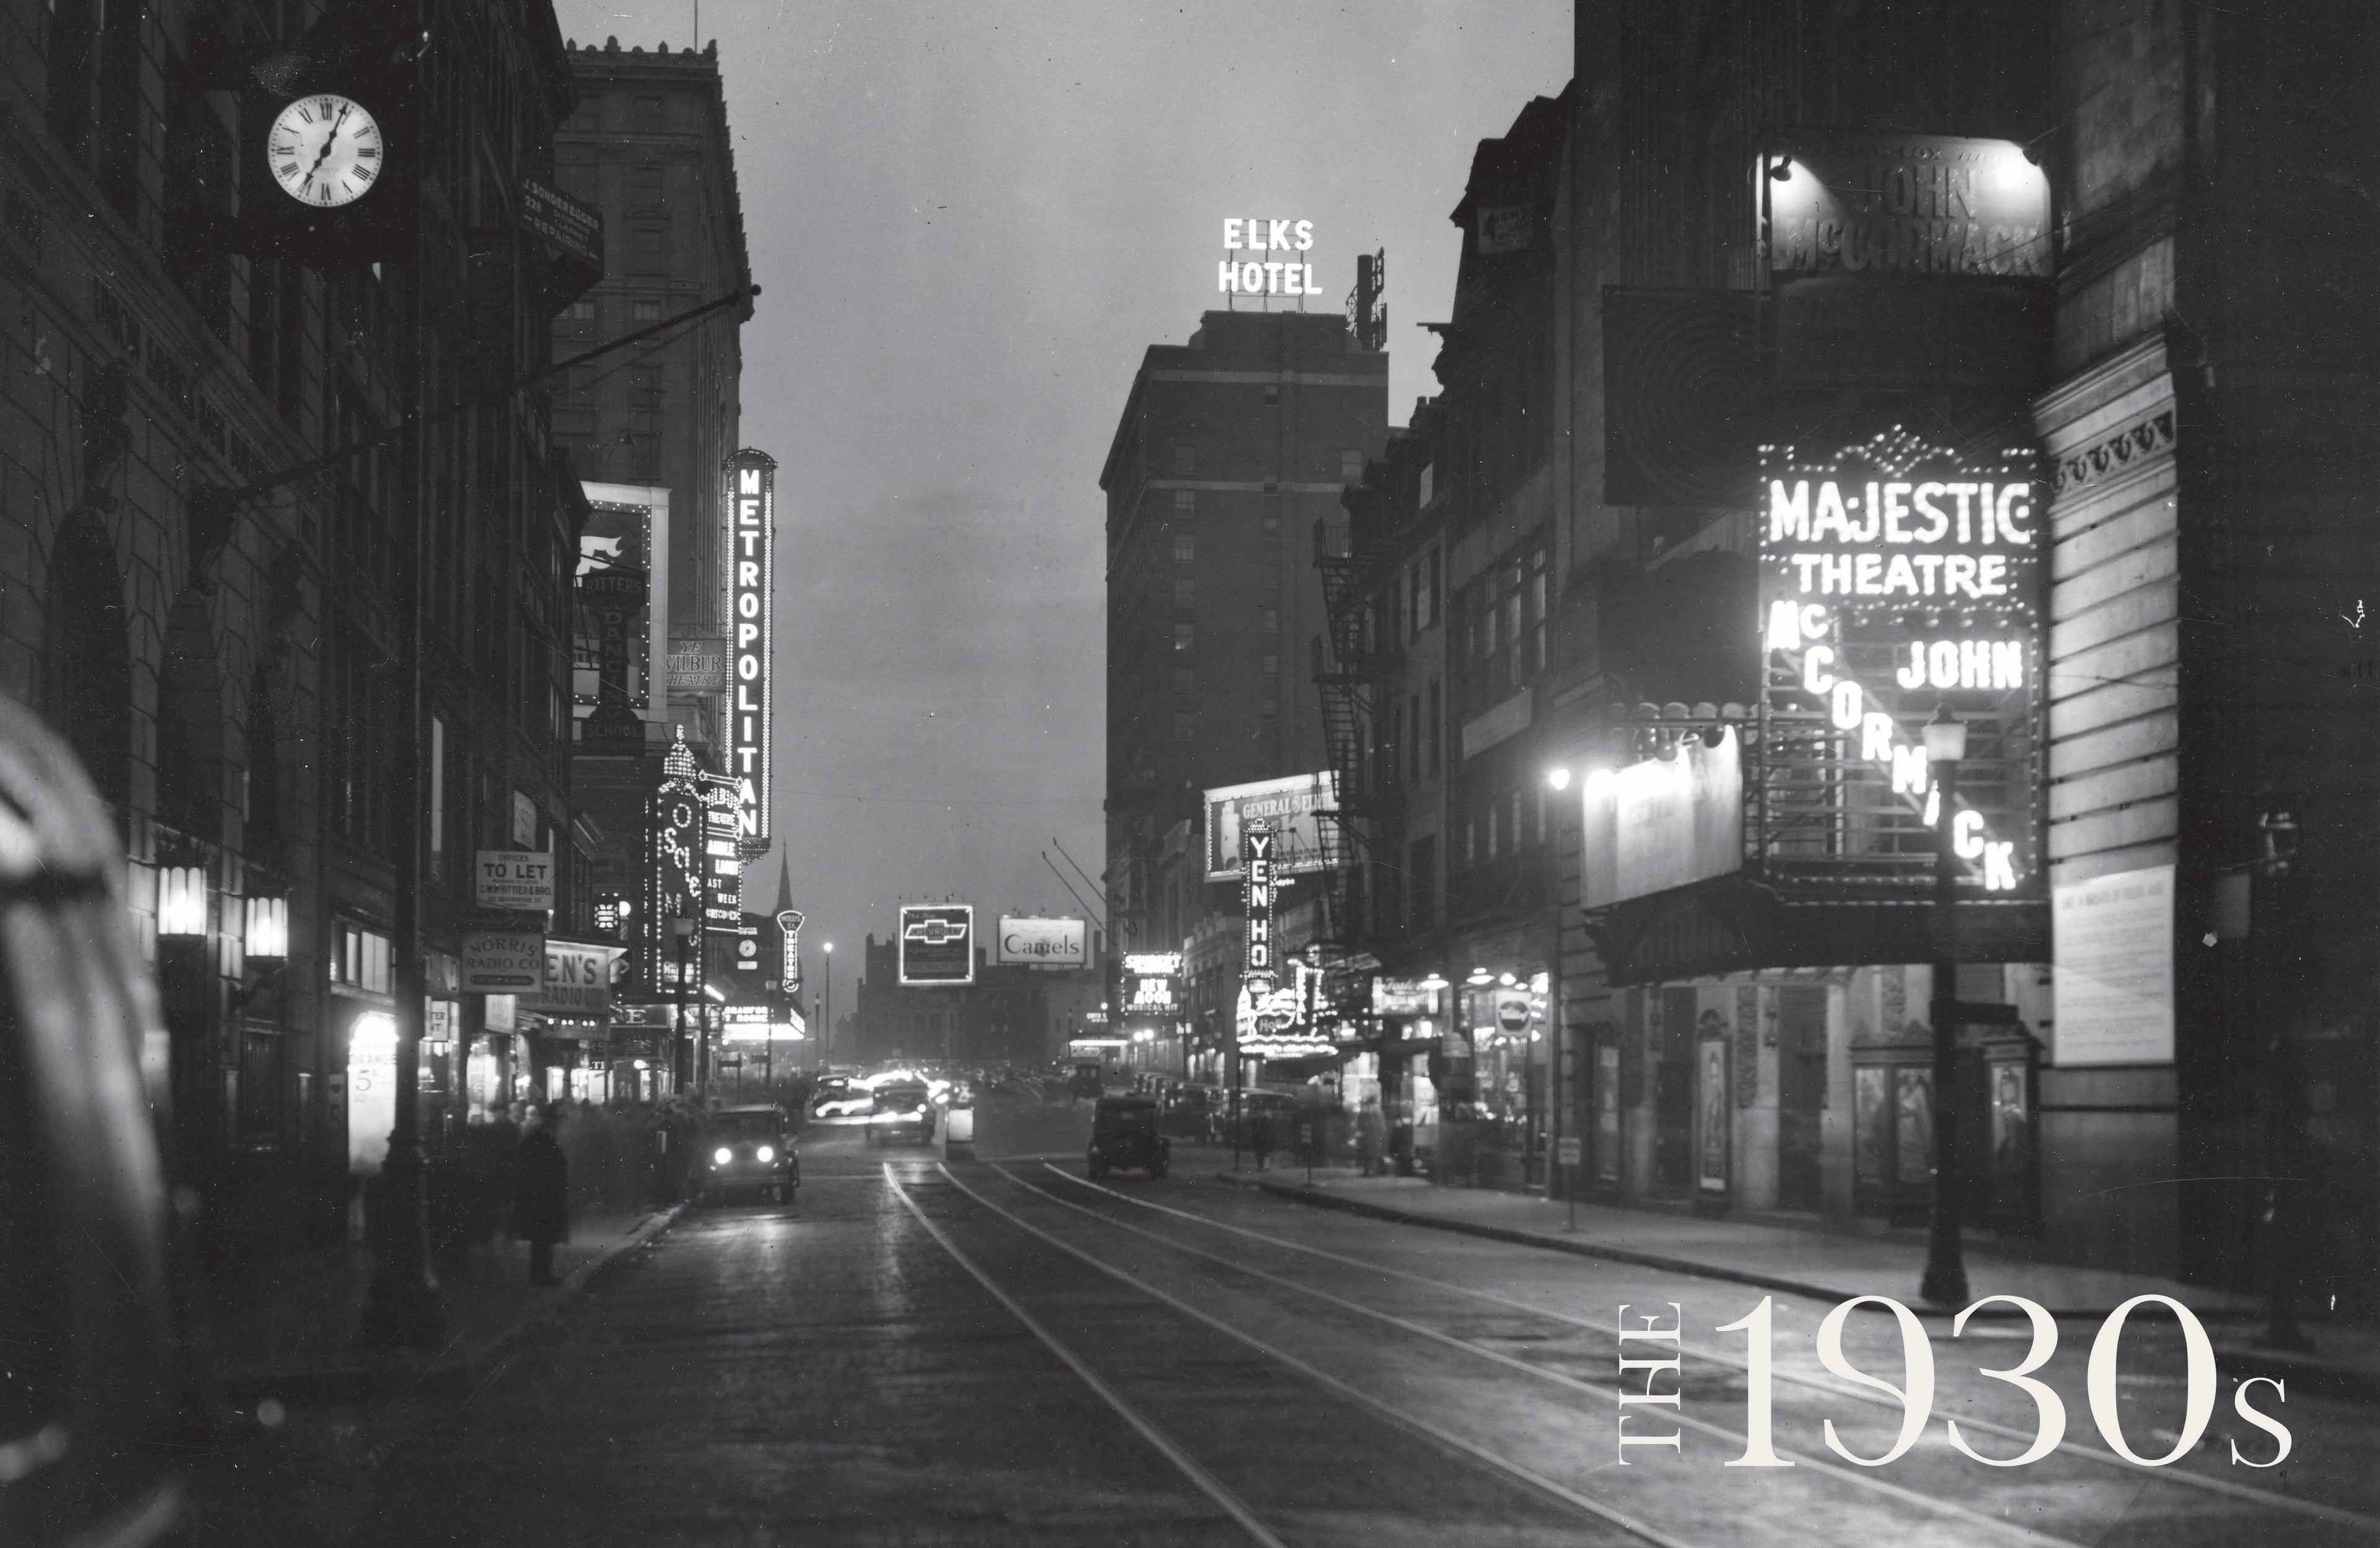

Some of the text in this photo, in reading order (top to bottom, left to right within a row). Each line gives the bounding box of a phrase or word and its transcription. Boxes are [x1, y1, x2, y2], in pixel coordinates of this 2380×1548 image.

[1224, 218, 1314, 251] ELKS
[1219, 262, 1323, 295] HOTEL
[1769, 480, 2032, 545] MAJESTIC
[1792, 553, 2008, 598] THEATRE
[679, 641, 703, 654] YE
[738, 468, 760, 837] METROPOLITAN
[1897, 641, 2023, 690] JOHN
[706, 787, 740, 814] ILBUR
[1242, 797, 1292, 819] GENERAL
[483, 863, 547, 880] TO LET
[1250, 836, 1269, 967] YEN HO
[780, 914, 802, 923] HOLLIS
[470, 938, 537, 957] NORRIS
[787, 930, 795, 980] THEATRE
[1003, 933, 1080, 956] Camels
[465, 957, 514, 969] RADIO
[1133, 990, 1172, 1005] MOON
[1140, 978, 1168, 992] NEW
